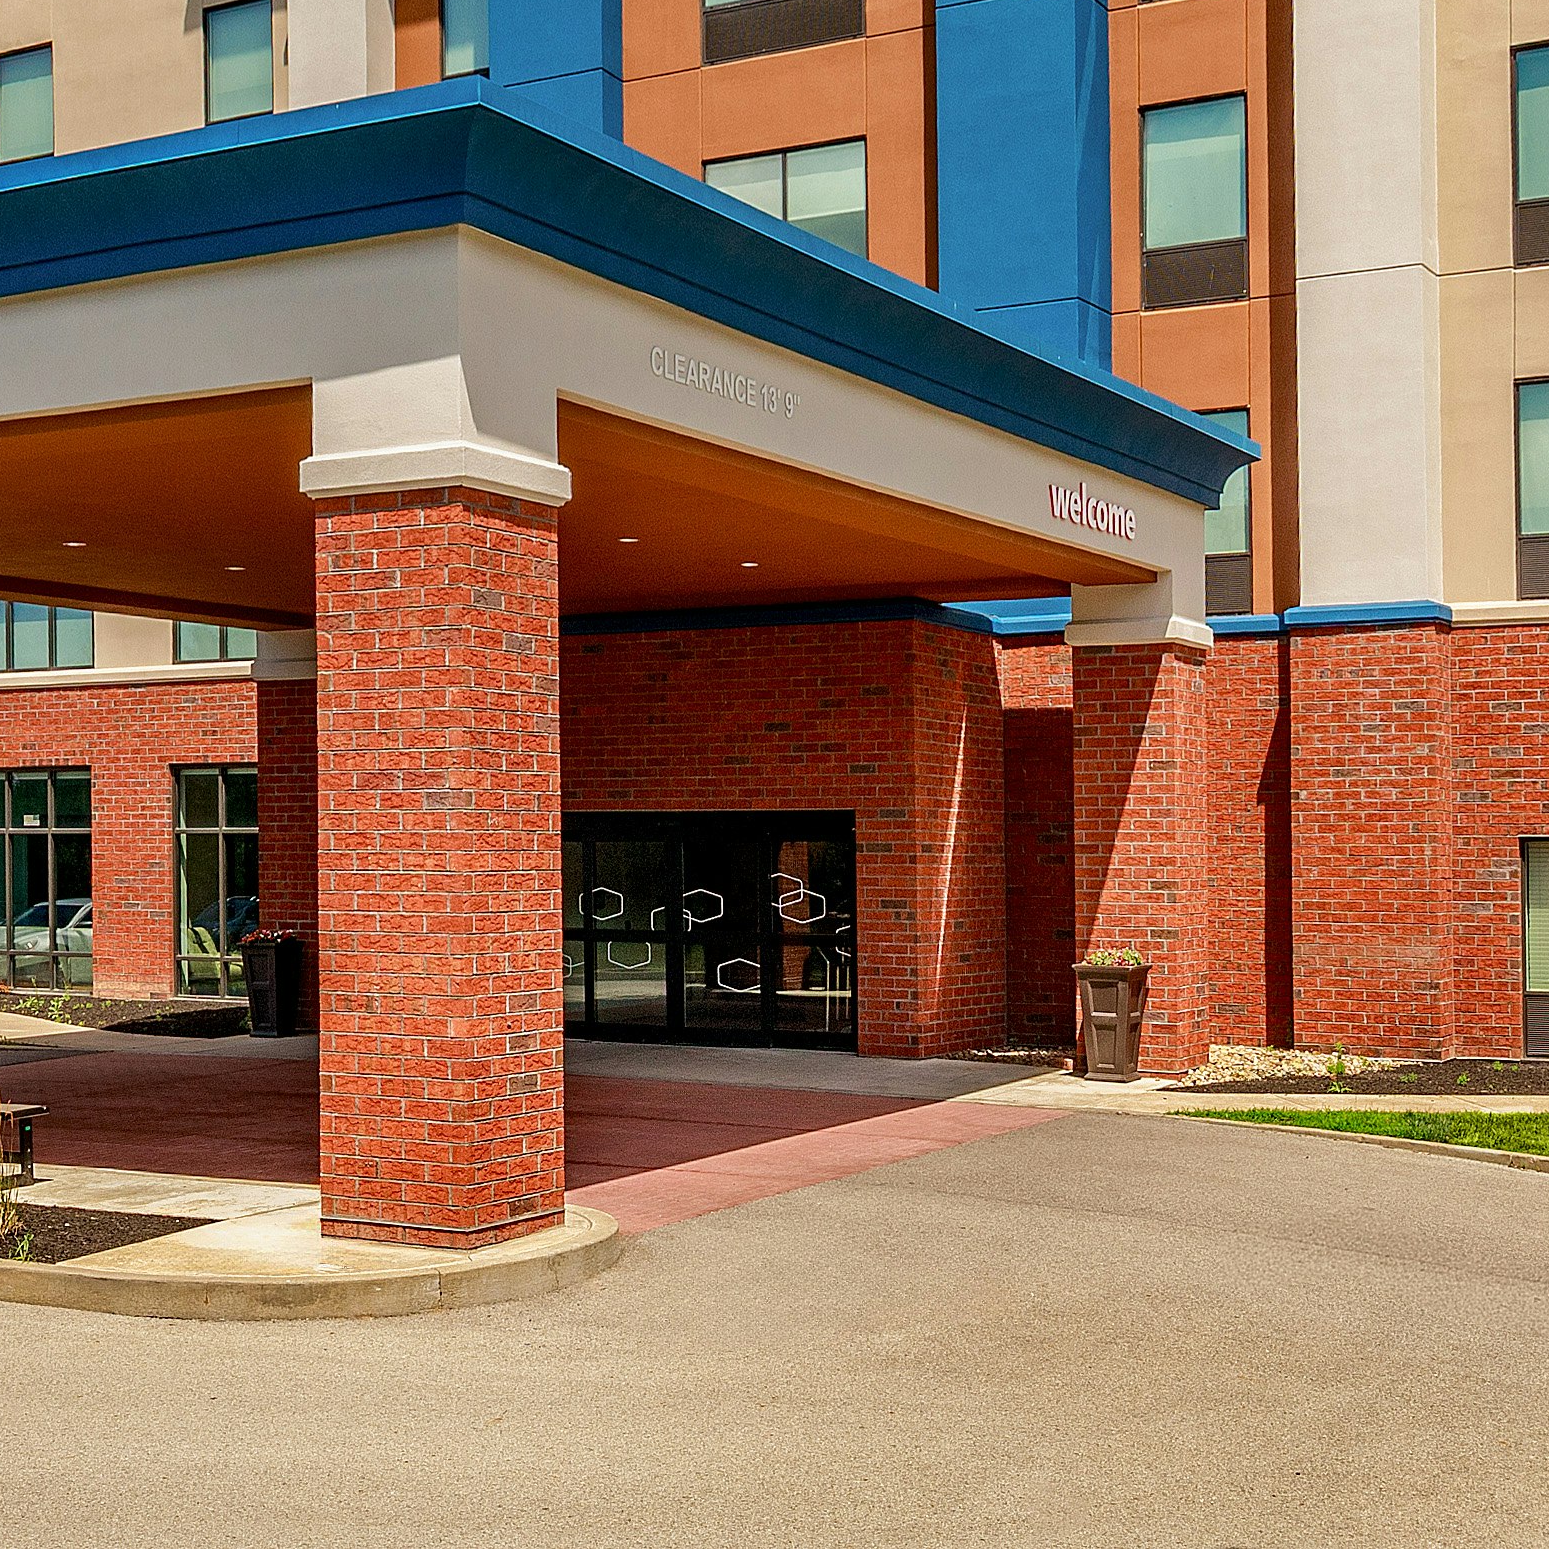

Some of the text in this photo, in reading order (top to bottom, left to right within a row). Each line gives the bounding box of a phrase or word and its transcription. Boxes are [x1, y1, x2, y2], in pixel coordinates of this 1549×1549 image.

[650, 345, 757, 407] CLEARANCE
[760, 383, 781, 413] 13'
[1048, 482, 1136, 541] welcome
